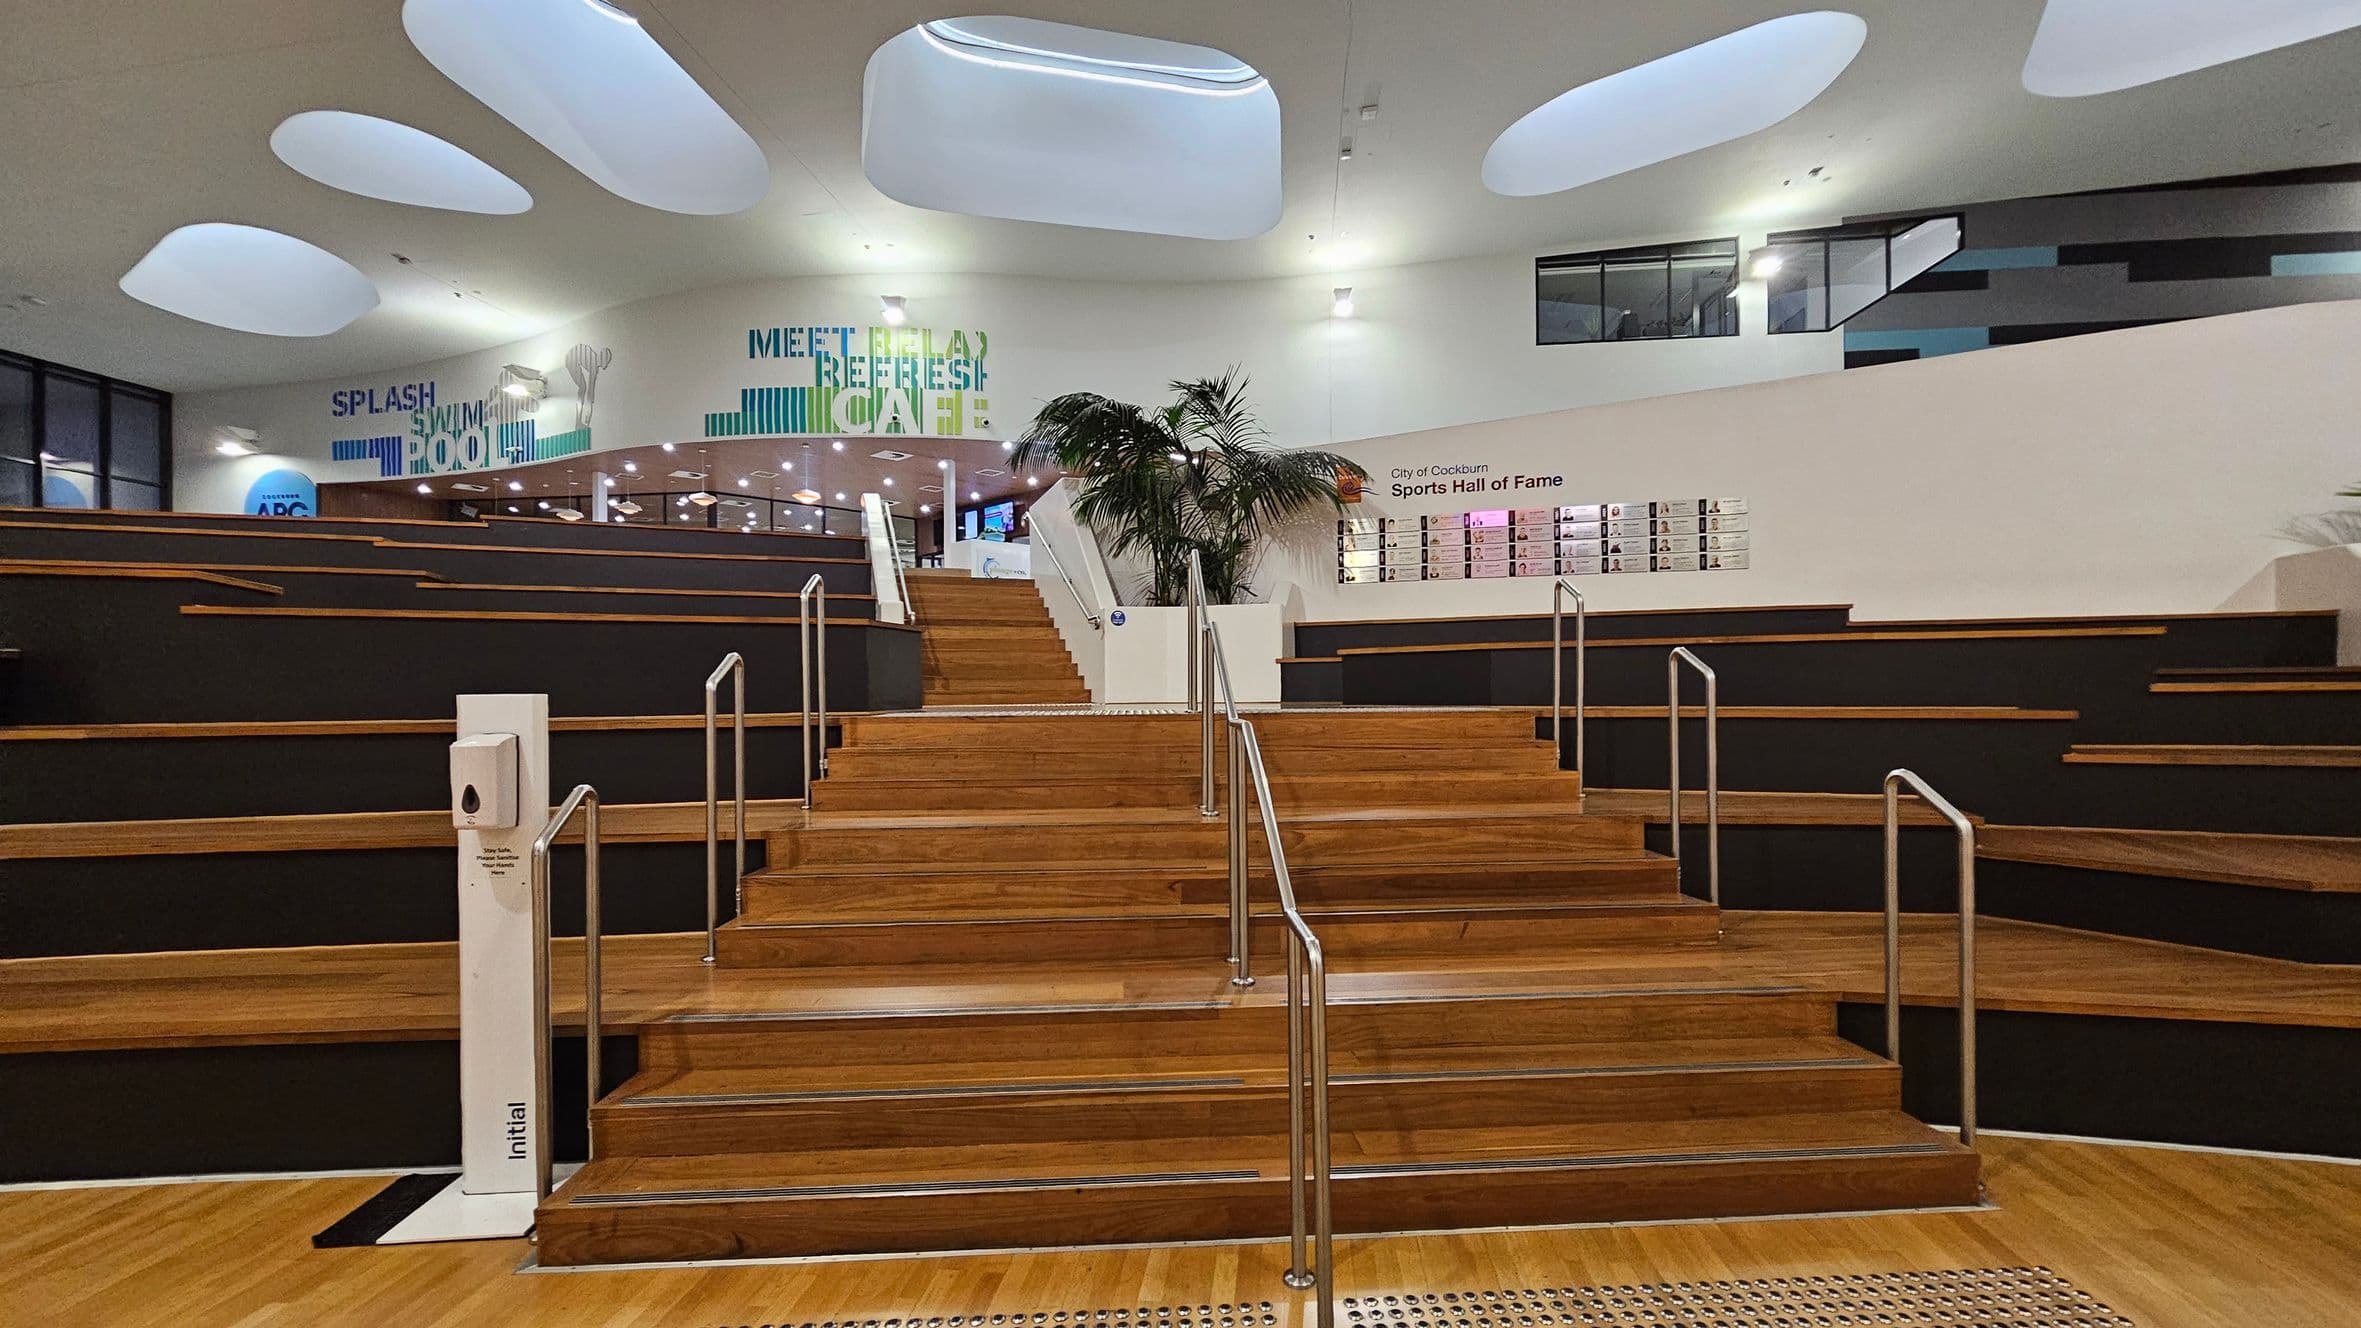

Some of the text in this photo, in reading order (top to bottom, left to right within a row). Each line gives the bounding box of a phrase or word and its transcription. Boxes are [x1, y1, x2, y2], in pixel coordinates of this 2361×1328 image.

[749, 327, 856, 359] MEET
[332, 381, 435, 417] SPLASH
[831, 386, 989, 434] CAFE
[410, 400, 484, 438] SWIM
[401, 416, 509, 476] POOL
[1391, 464, 1489, 480] City of Cockburn
[1391, 475, 1564, 499] Sports Hall of Fame
[506, 1102, 526, 1160] Initial
